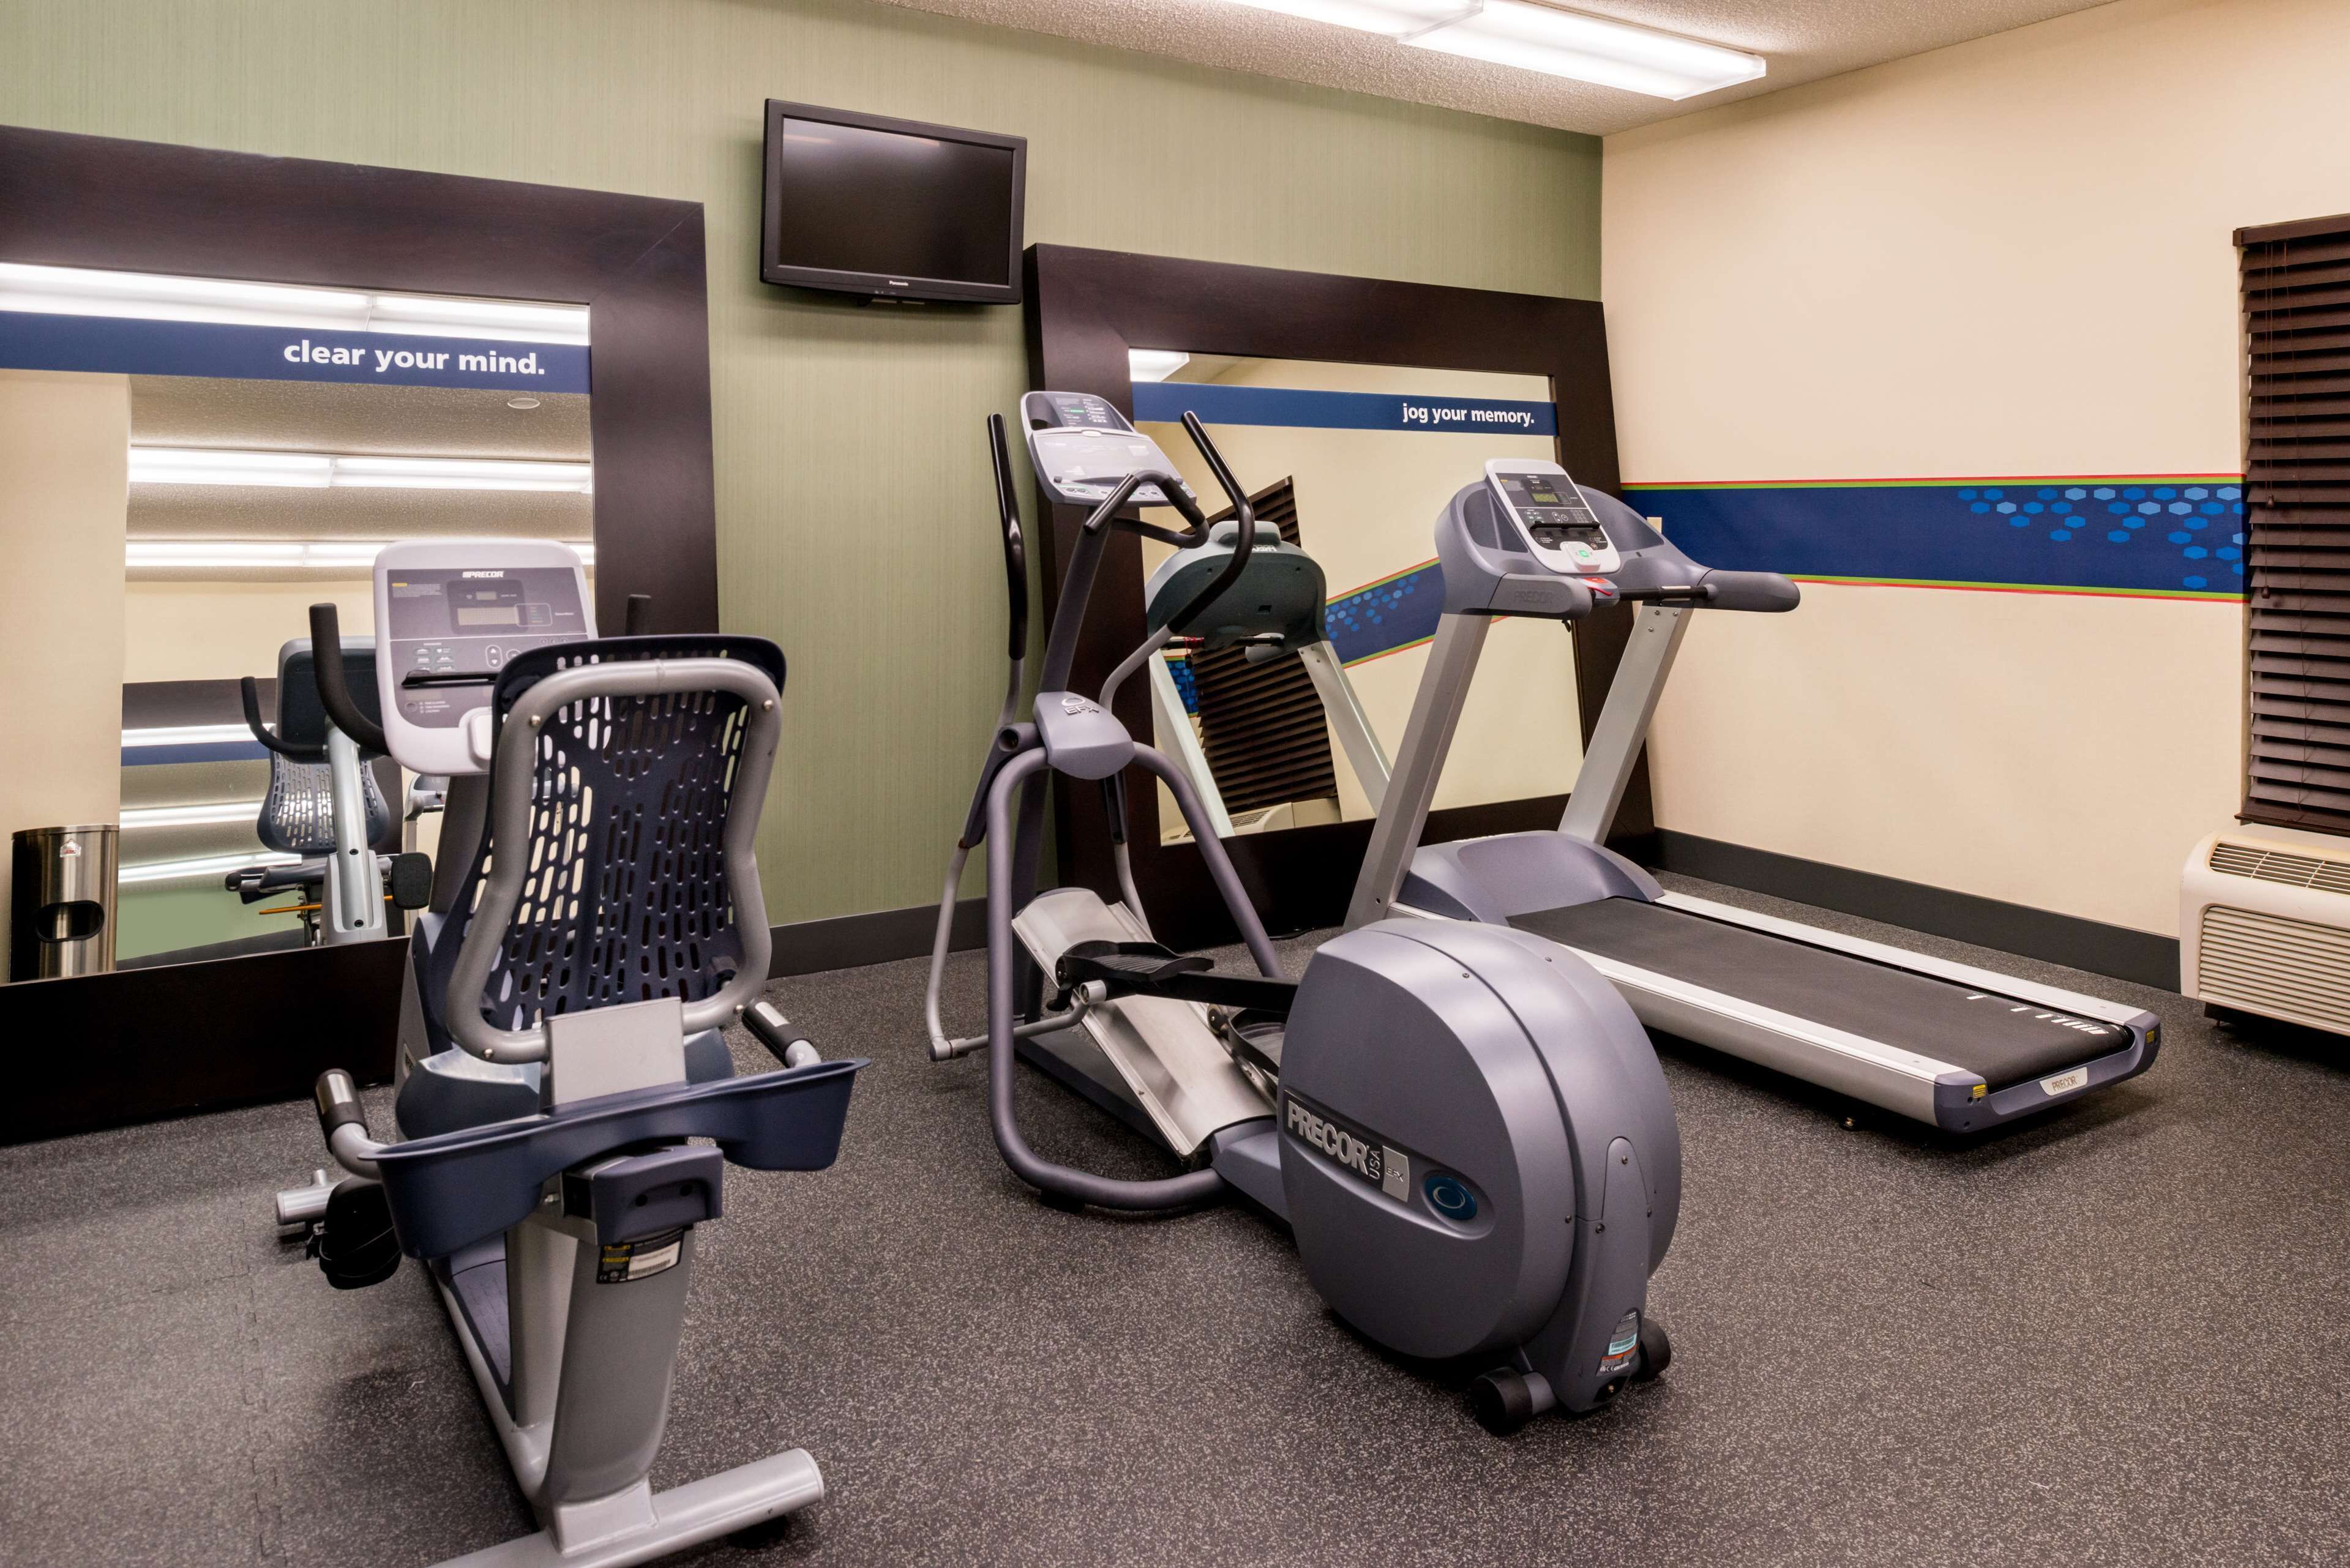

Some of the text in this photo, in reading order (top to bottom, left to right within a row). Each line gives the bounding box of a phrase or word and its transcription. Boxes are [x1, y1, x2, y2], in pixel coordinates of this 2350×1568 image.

[284, 340, 545, 375] clear your mind.
[1402, 403, 1535, 427] jog your memory.
[1065, 706, 1099, 715] EFX
[2051, 1075, 2078, 1092] PRECOR
[1288, 1100, 1369, 1176] PRECOR
[1369, 1150, 1380, 1180] USA
[1386, 1165, 1404, 1182] EFX
